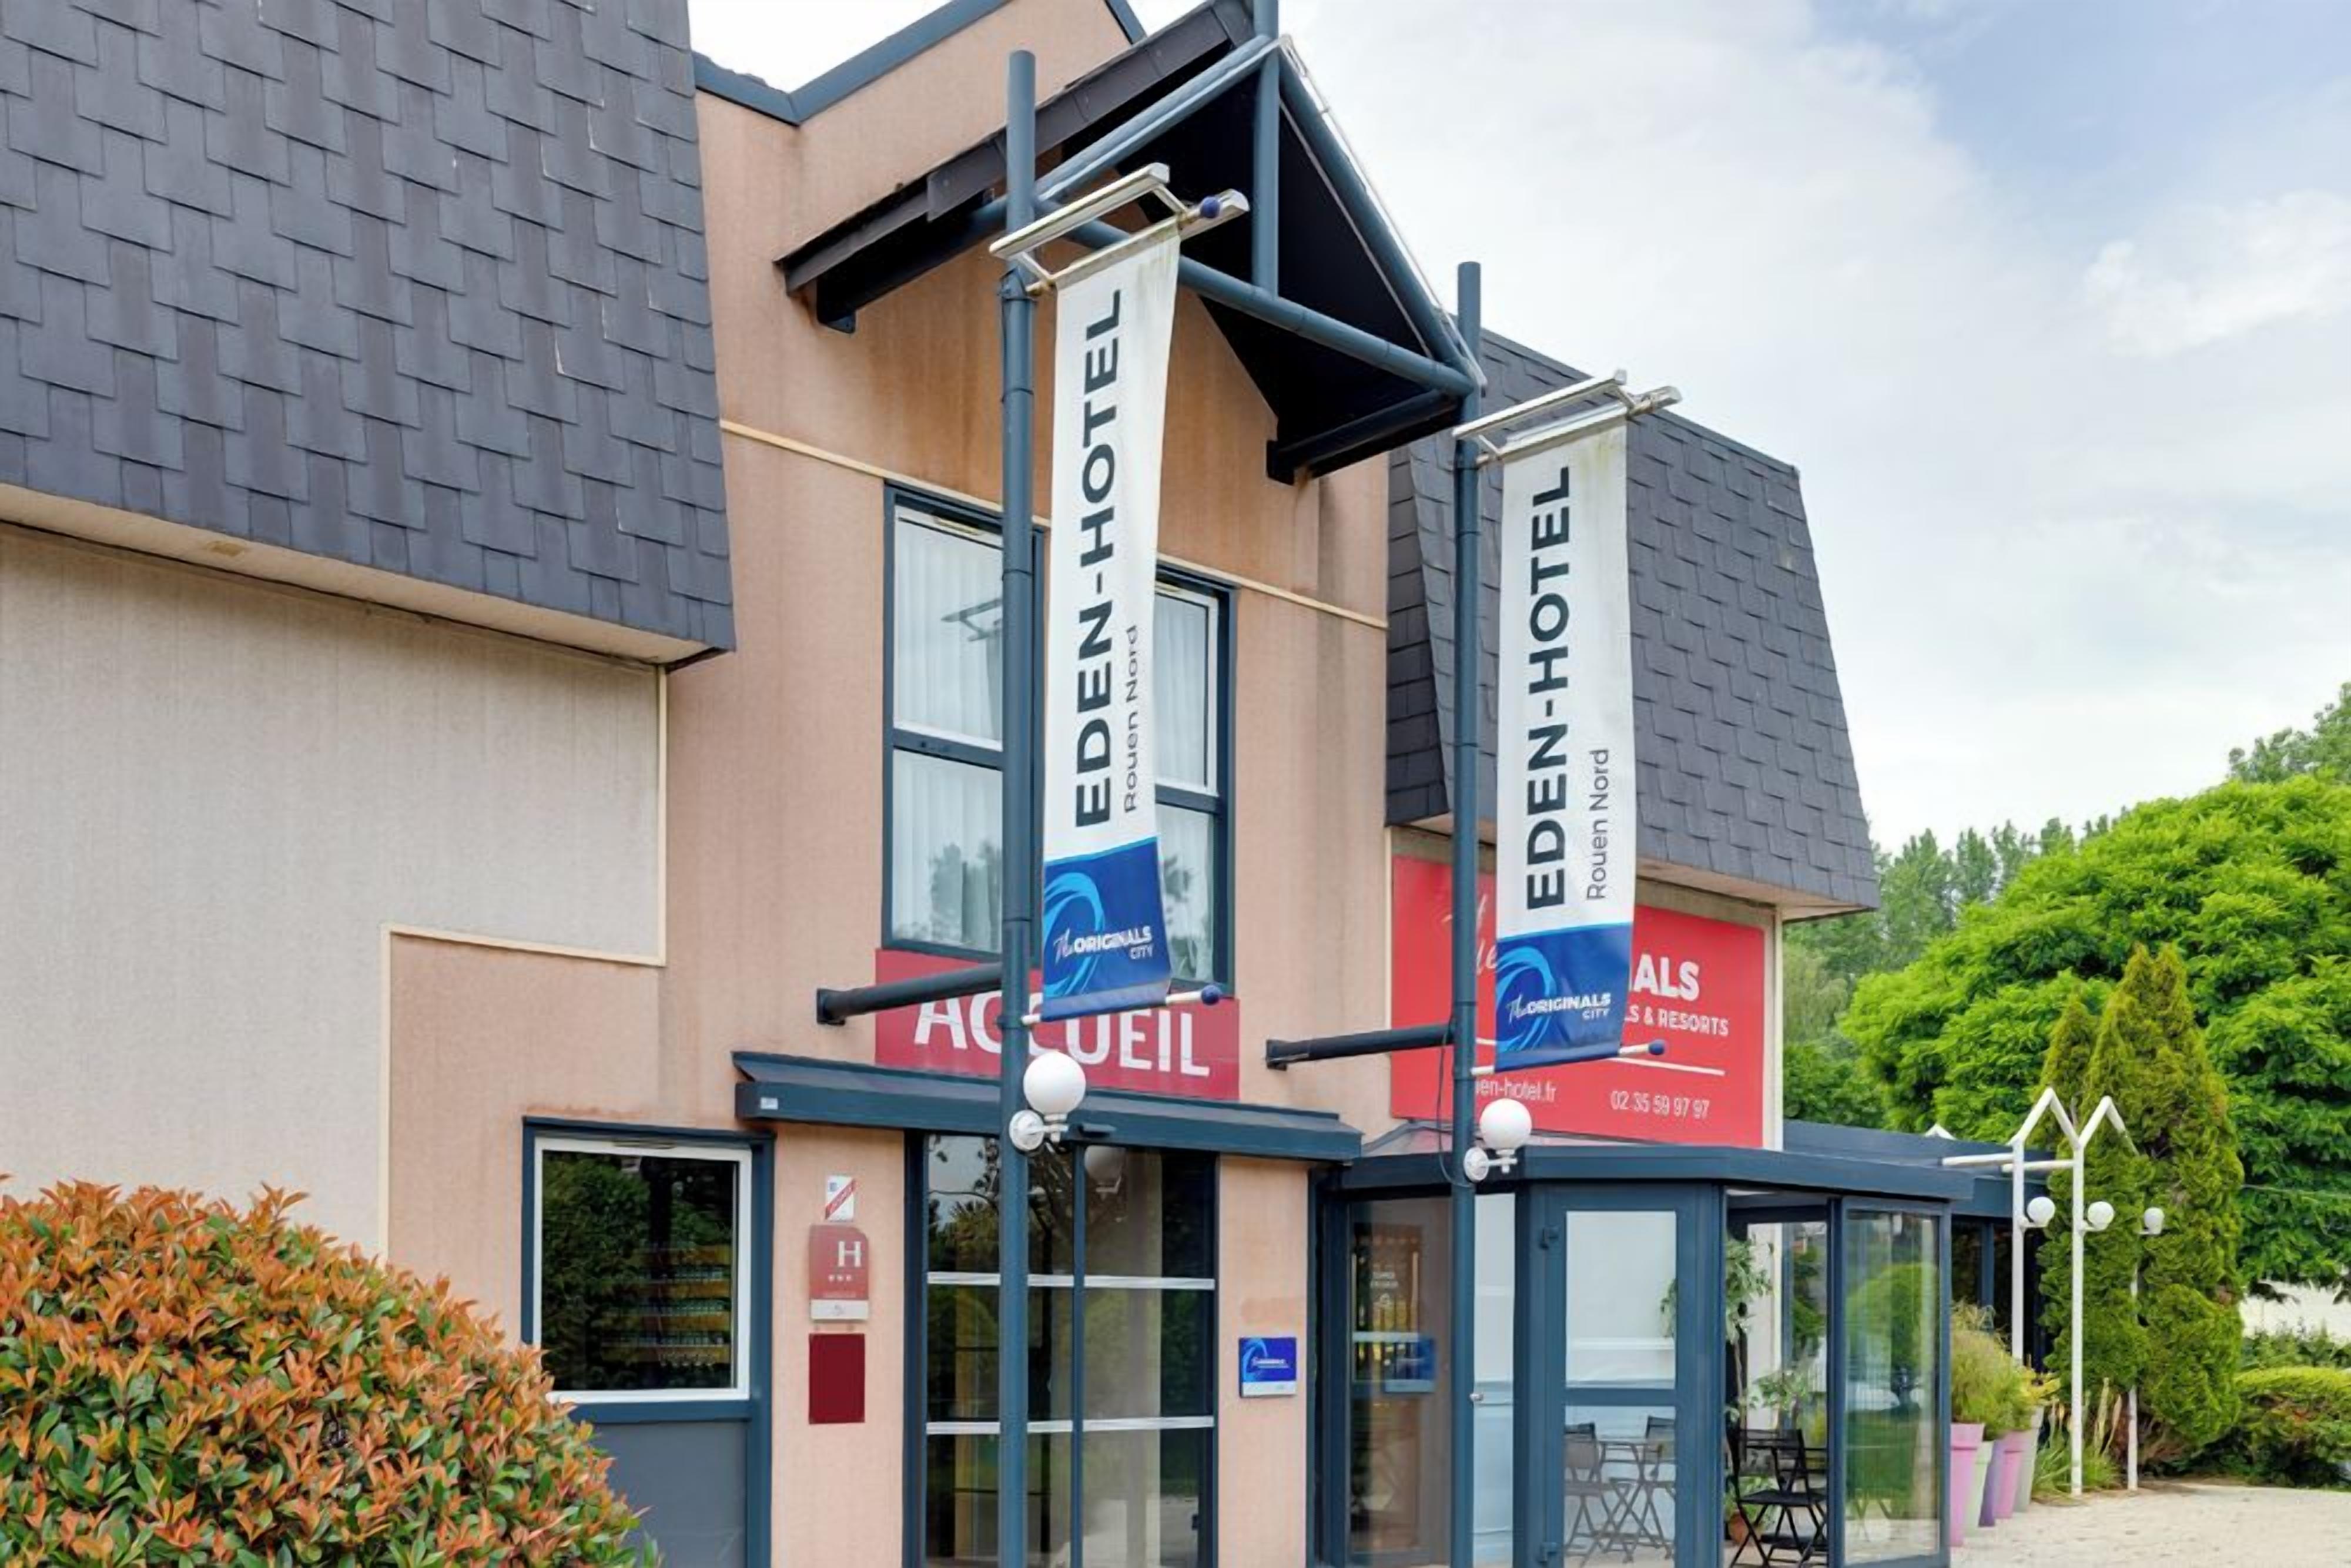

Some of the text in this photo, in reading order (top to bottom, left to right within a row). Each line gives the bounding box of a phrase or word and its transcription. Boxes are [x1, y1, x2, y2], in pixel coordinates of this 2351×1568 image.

[1076, 289, 1121, 827] EDEN-HOTEL
[1526, 466, 1570, 910] EDEN-HOTEL
[1124, 625, 1138, 813] Rouen Nord
[1586, 748, 1609, 901] Rouen Nord
[1074, 925, 1153, 954] ORIGINALS
[1129, 944, 1153, 960] CITY
[1527, 991, 1612, 1015] ORIGINALS
[1582, 1007, 1610, 1021] CITY
[1657, 1007, 1729, 1037] RESORTS
[1610, 1090, 1630, 1110] 02
[1633, 1091, 1650, 1113] 35
[838, 1240, 862, 1268] H
